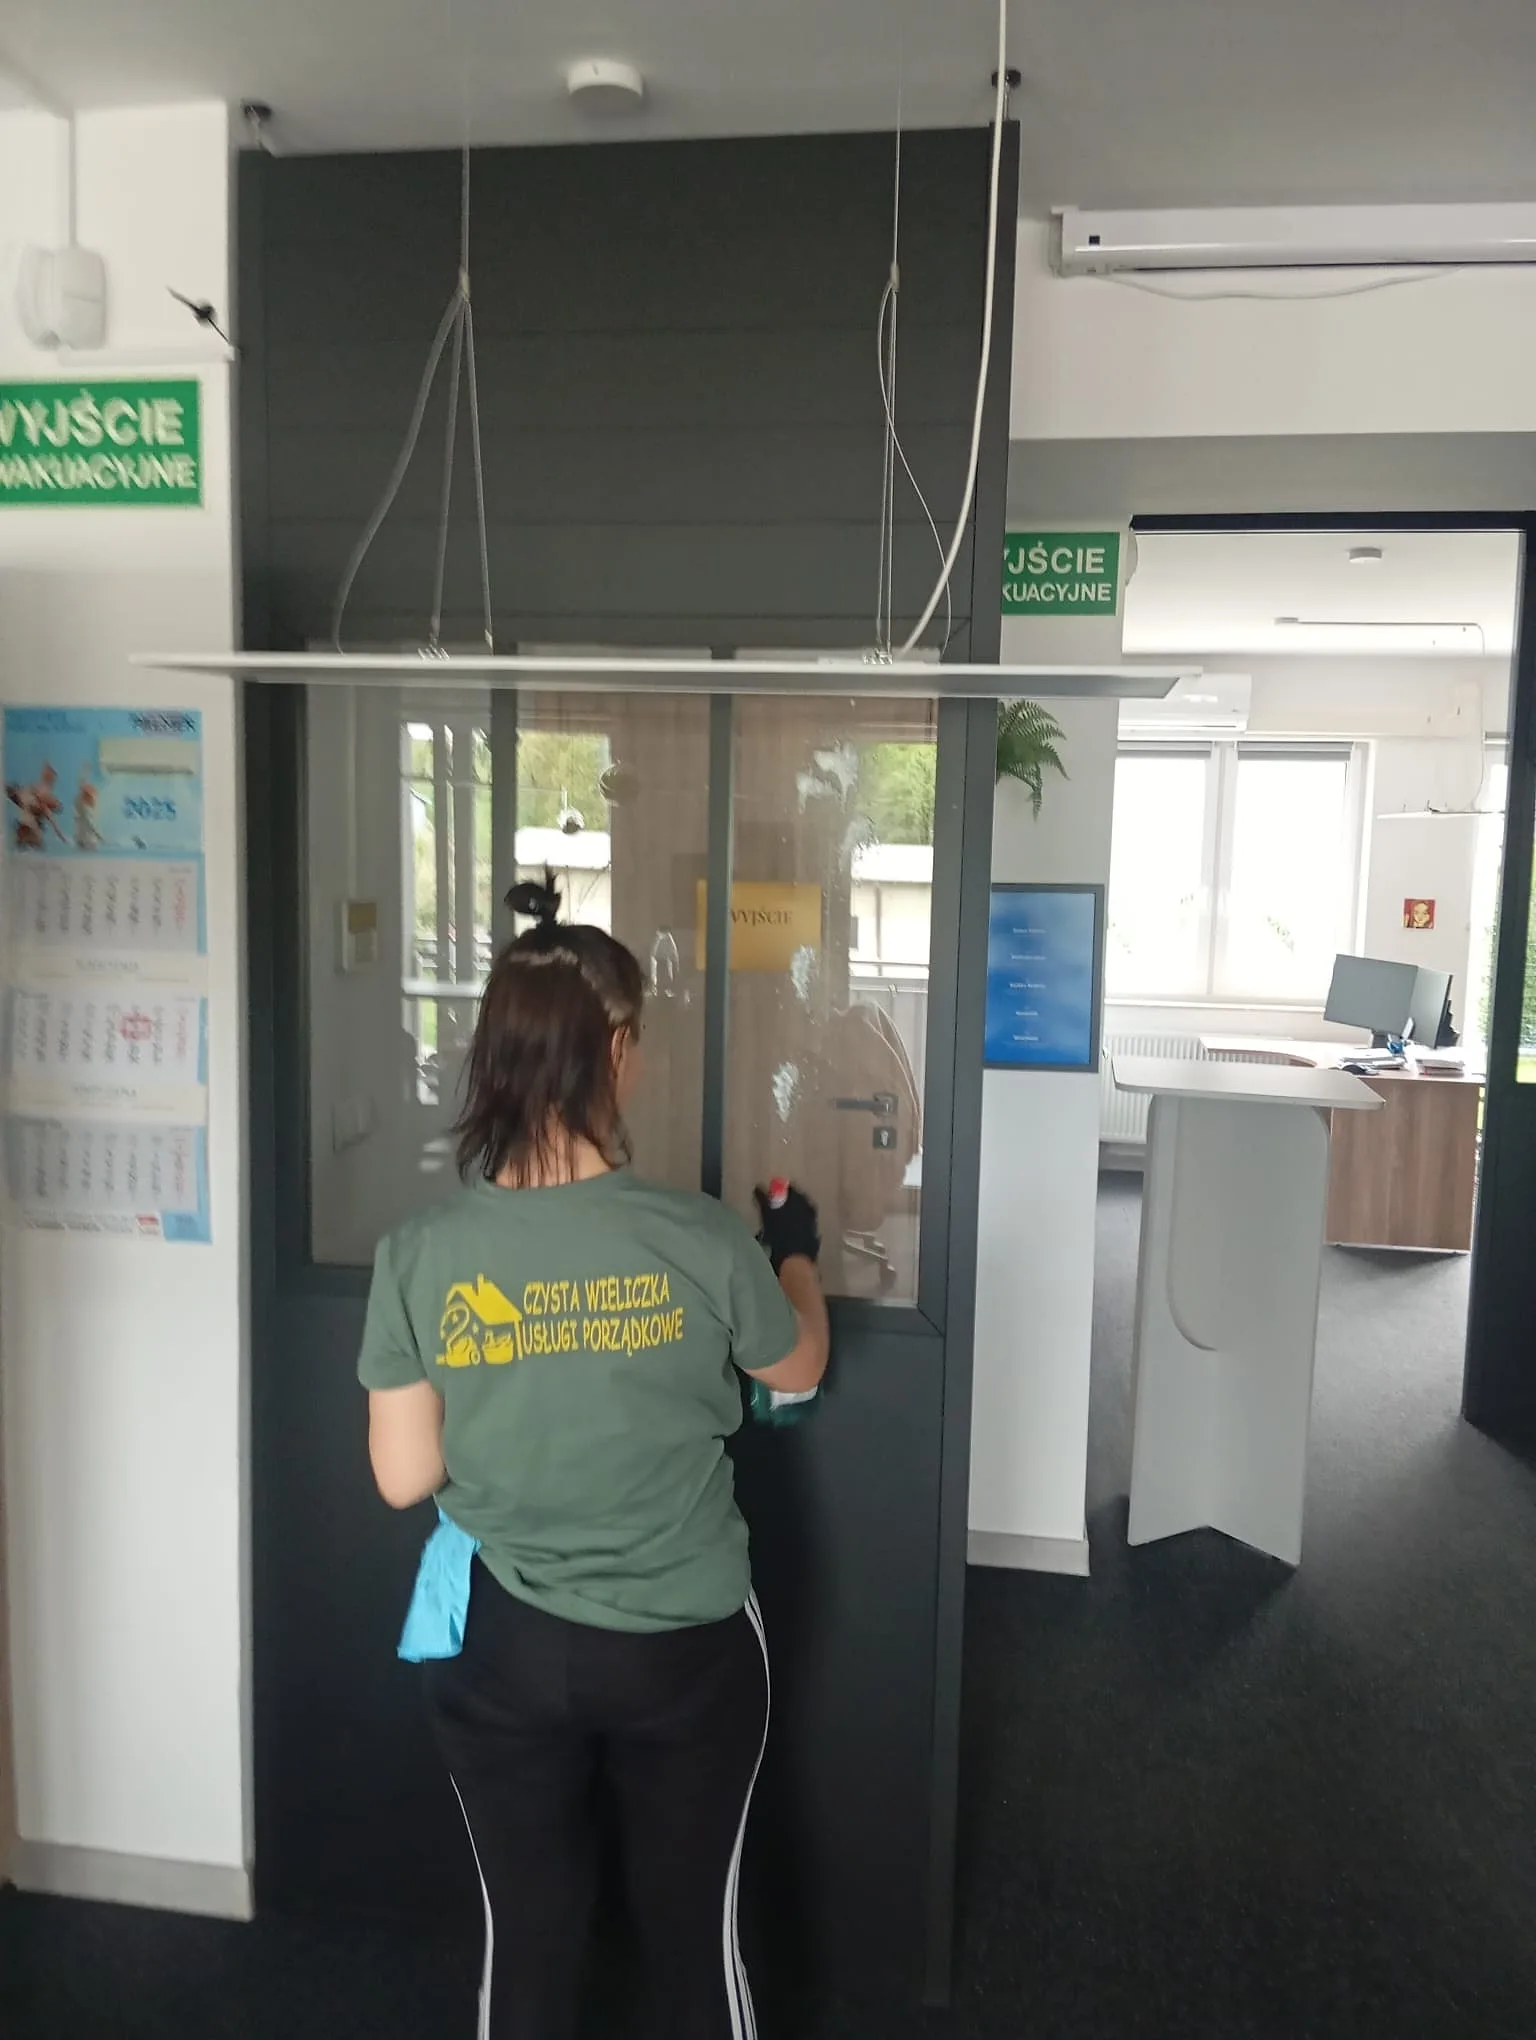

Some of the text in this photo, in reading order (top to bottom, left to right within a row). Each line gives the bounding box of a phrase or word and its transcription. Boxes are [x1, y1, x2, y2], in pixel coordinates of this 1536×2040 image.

[1003, 541, 1105, 574] JŚCIE
[523, 1272, 670, 1315] CZYSTA WIELICZKA
[523, 1308, 684, 1357] USŁUGI PORZĄDKOWE
